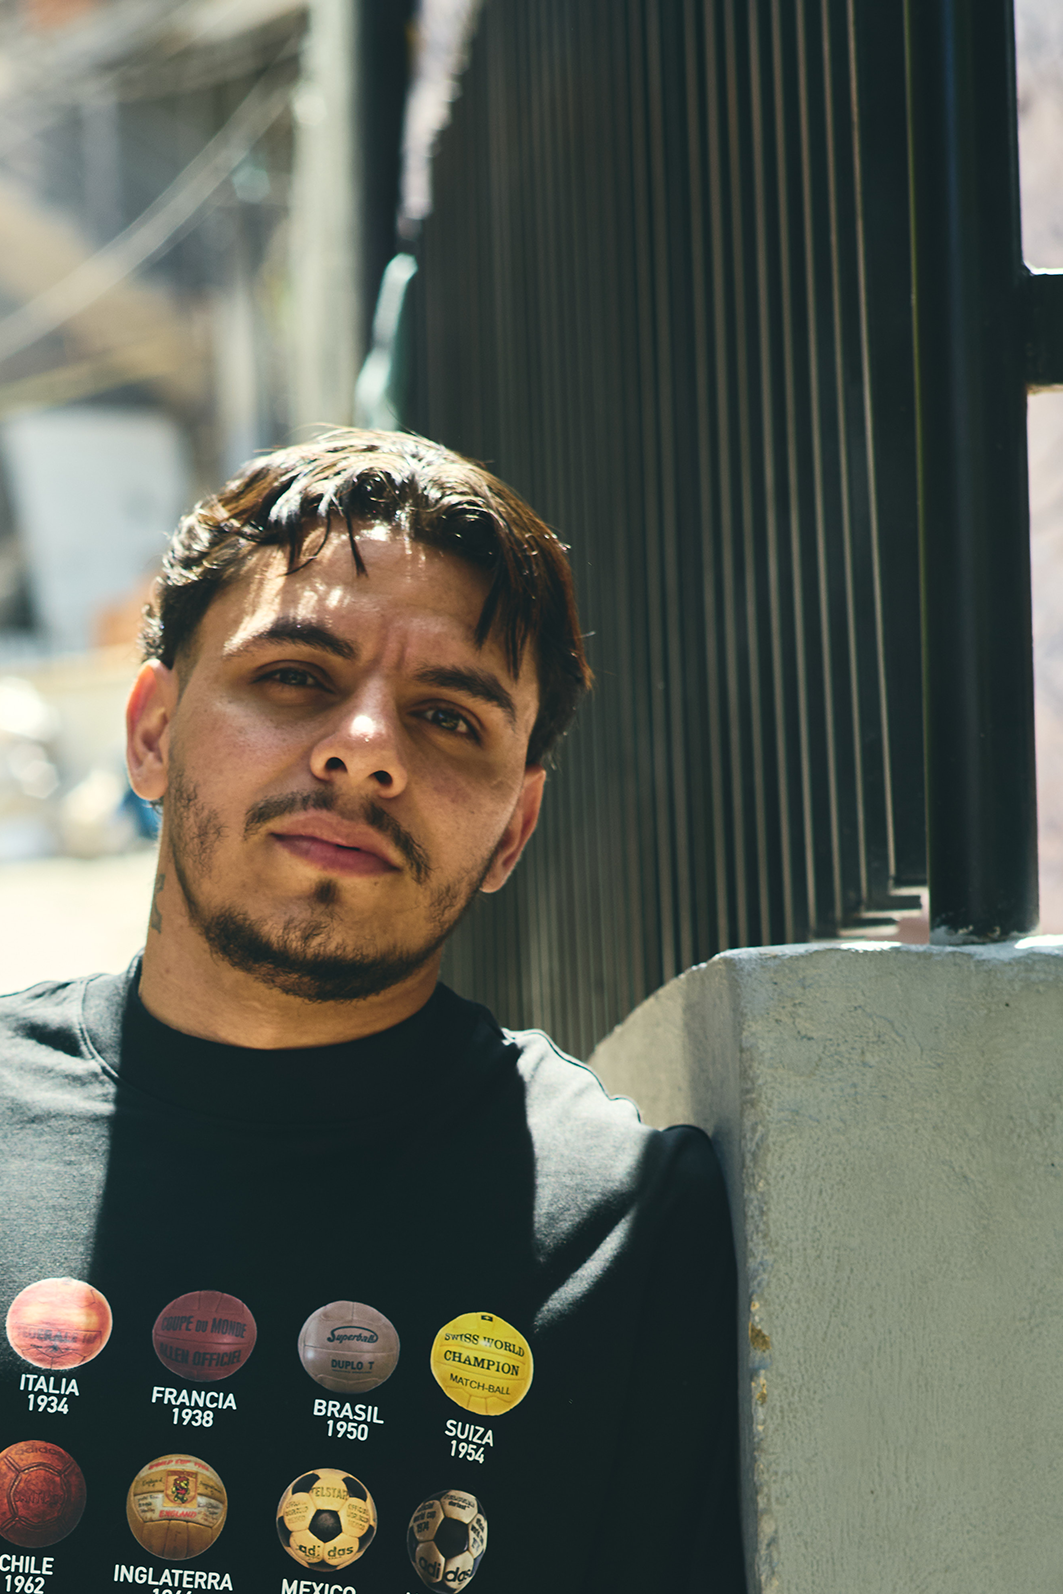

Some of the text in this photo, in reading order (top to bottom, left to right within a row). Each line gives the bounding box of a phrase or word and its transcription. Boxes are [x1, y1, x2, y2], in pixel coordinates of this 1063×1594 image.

[161, 1315, 247, 1339] COUPE DU MONDE
[327, 1326, 378, 1344] Superball
[444, 1332, 525, 1357] SWISS WORLD
[192, 1349, 242, 1367] OFFICIEL
[331, 1359, 375, 1371] DUPLO T
[444, 1350, 519, 1376] CHAMPION
[19, 1373, 80, 1397] ITALIA
[450, 1373, 511, 1396] MATCH-BALL
[27, 1394, 69, 1415] 1934
[151, 1386, 237, 1411] FRANCIA
[172, 1407, 214, 1428] 1938
[313, 1398, 385, 1425] BRASIL
[326, 1419, 369, 1442] 1950
[444, 1419, 495, 1447] SUIZA
[450, 1439, 486, 1464] 1954
[159, 1509, 197, 1519] ENGLAND
[327, 1546, 354, 1558] das
[113, 1563, 234, 1592] INGLATERRA
[419, 1556, 441, 1579] adi
[4, 1574, 45, 1594] 1962
